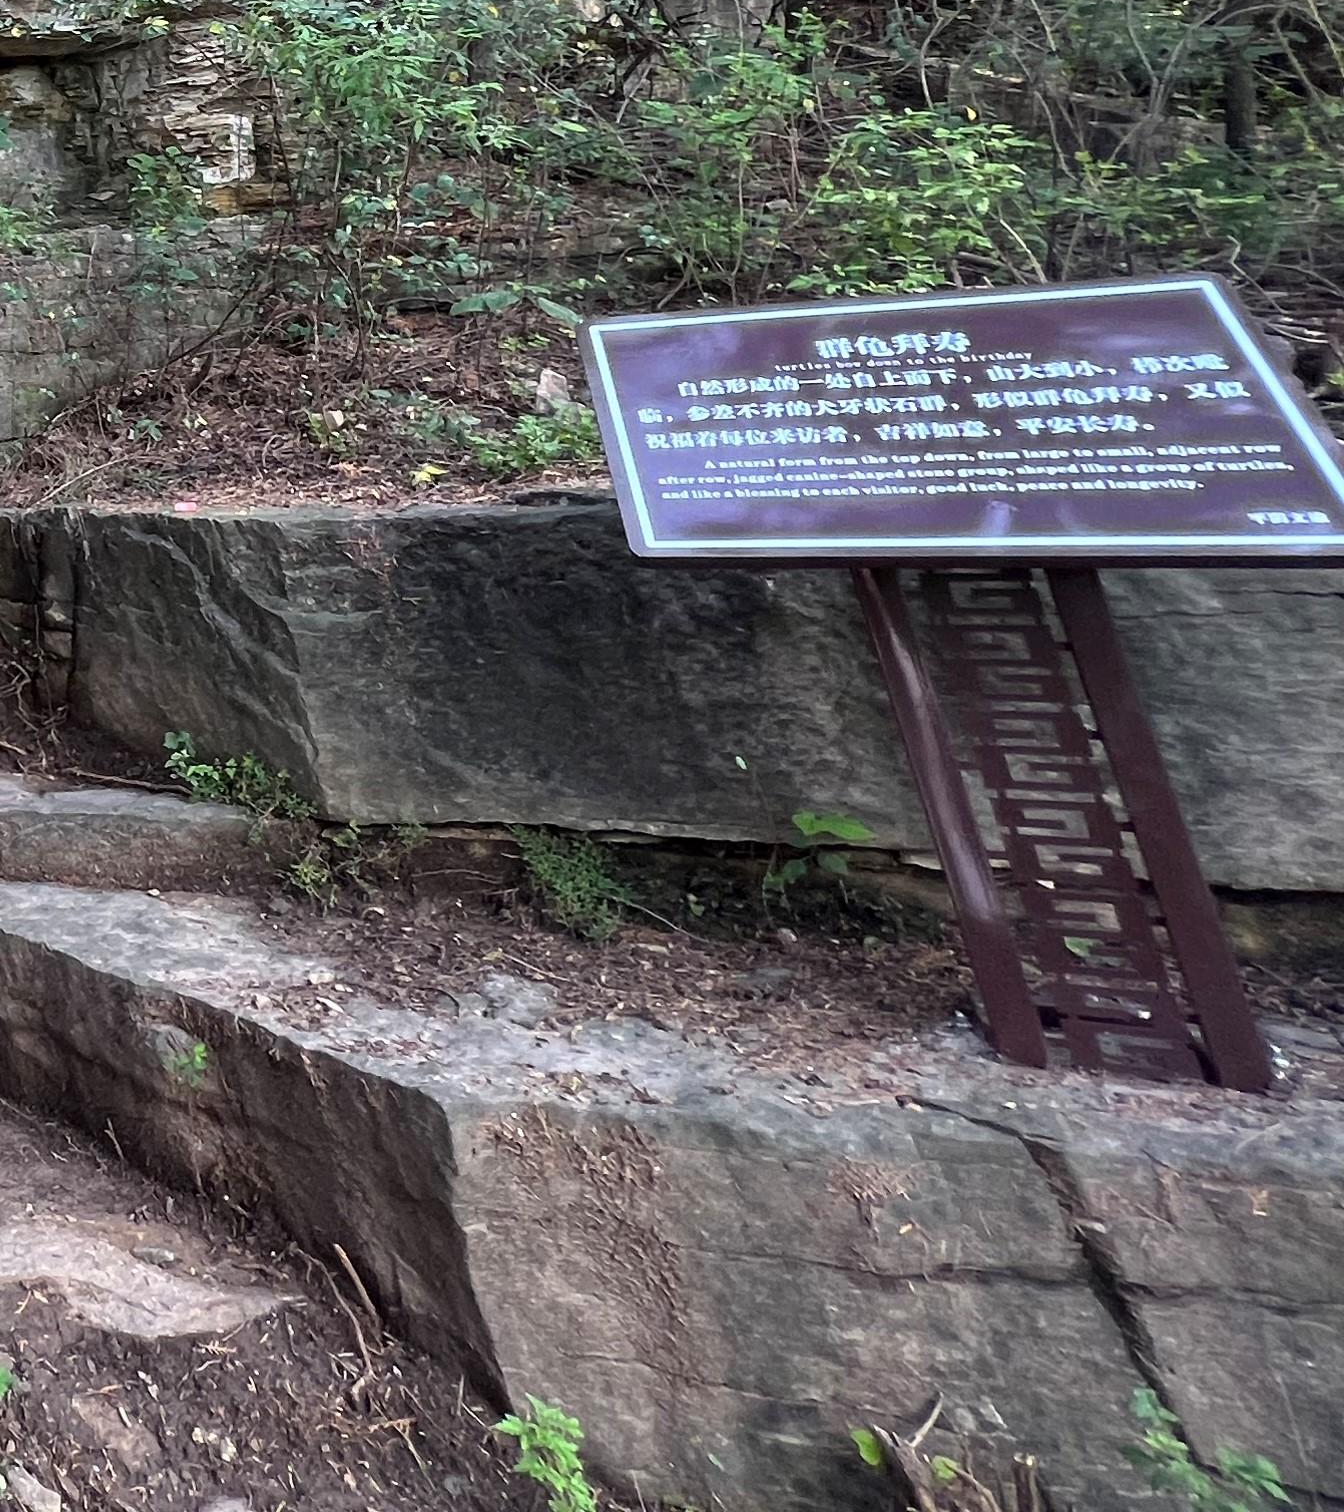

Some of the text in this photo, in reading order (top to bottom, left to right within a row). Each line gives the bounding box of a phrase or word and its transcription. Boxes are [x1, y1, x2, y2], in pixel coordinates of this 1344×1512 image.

[815, 331, 972, 359] 群龟拜寿
[906, 357, 925, 366] to
[929, 354, 956, 364] the
[959, 351, 1033, 363] birthday
[704, 460, 717, 469] A
[719, 458, 776, 469] natural
[778, 457, 817, 467] form
[818, 456, 858, 466] from
[861, 454, 888, 464] the
[890, 454, 921, 464] top
[976, 450, 1021, 461] from
[1021, 449, 1070, 460] large
[1072, 448, 1094, 458] to
[1156, 444, 1241, 456] adjacent
[1242, 444, 1281, 454] row
[658, 474, 695, 485] after
[907, 468, 955, 478] stone
[1016, 463, 1080, 476] shaped
[1080, 462, 1119, 474] like
[1120, 464, 1134, 473] a
[1135, 462, 1192, 474] group
[1192, 461, 1216, 471] of
[661, 489, 690, 500] and
[691, 489, 721, 500] like
[723, 490, 734, 499] a
[735, 488, 801, 500] blessing
[802, 488, 820, 497] to
[822, 486, 860, 496] each
[925, 482, 968, 495] good
[1015, 481, 1069, 493] peace
[1071, 479, 1107, 491] and
